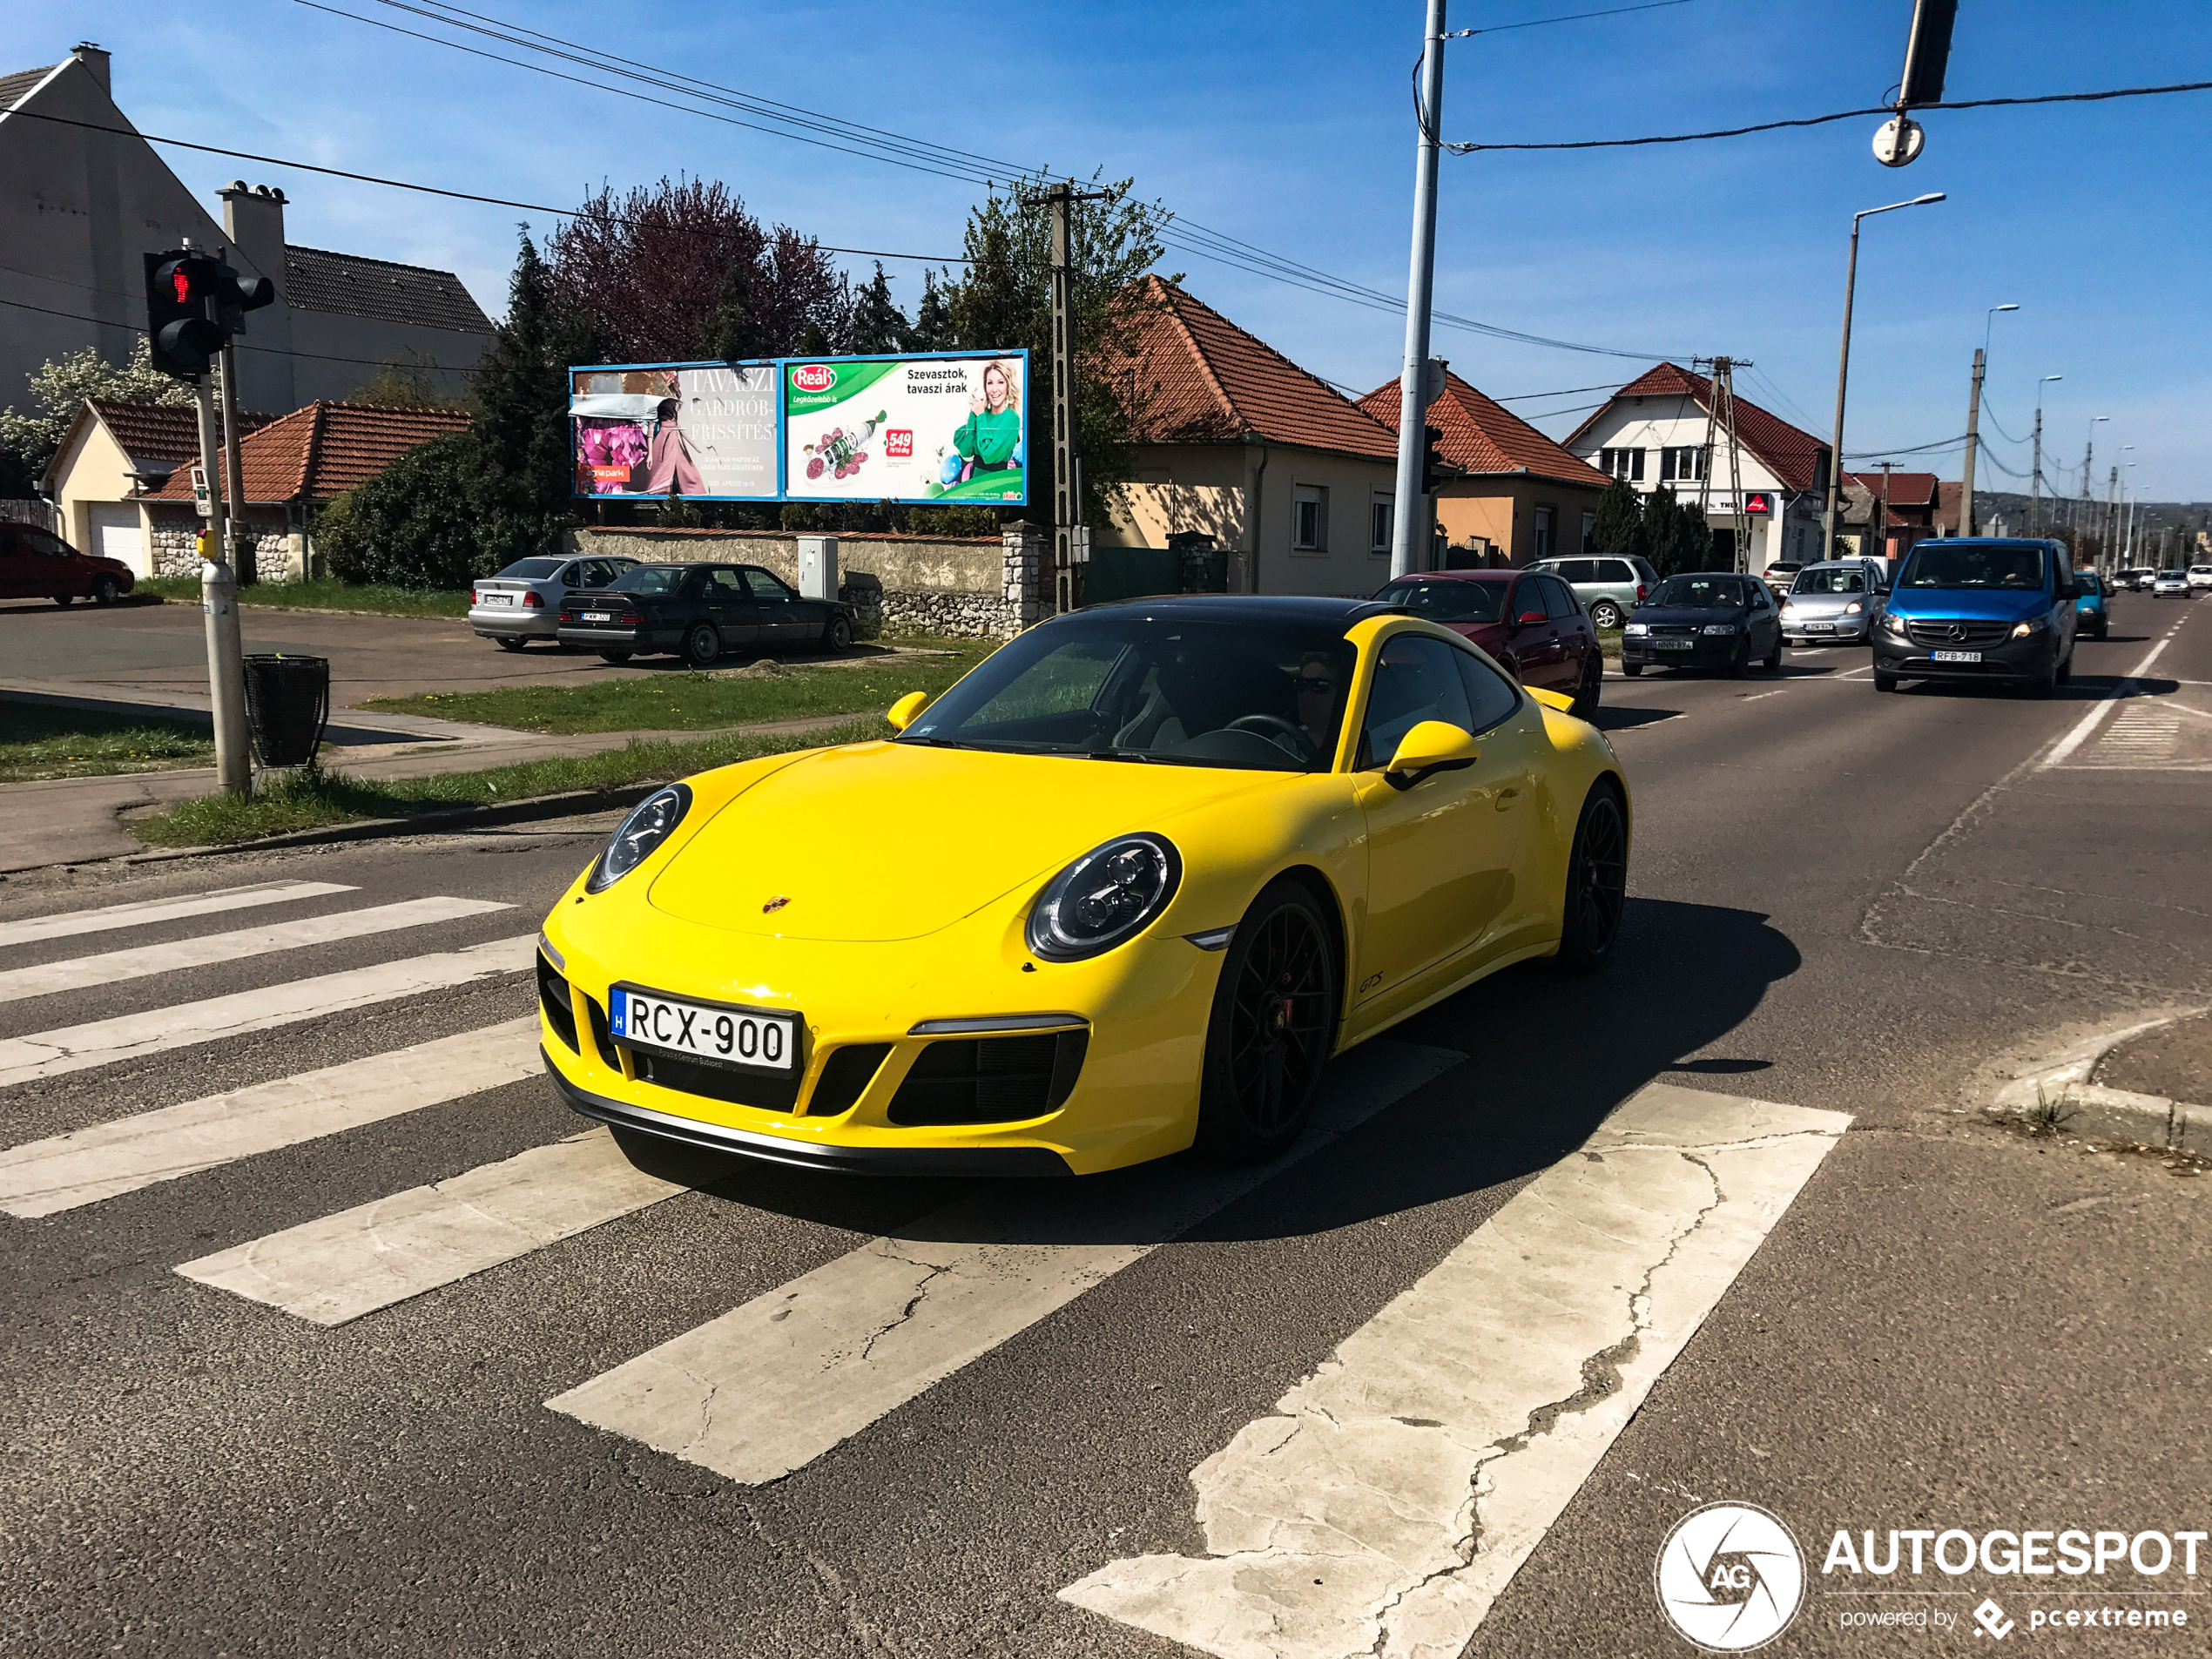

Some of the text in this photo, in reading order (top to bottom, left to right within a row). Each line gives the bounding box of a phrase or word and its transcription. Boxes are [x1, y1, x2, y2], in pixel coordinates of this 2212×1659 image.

[688, 368, 776, 393] TAVASZI
[797, 368, 827, 386] Reál
[907, 368, 968, 381] Szevasztok,
[907, 382, 968, 394] tavaszi árak
[690, 395, 774, 416] GARDRÓB-
[691, 420, 772, 441] FRISSÍTÉS
[889, 433, 912, 447] 549
[605, 469, 624, 478] park
[1937, 651, 1979, 661] RFB-718
[1359, 970, 1384, 993] GTS
[615, 997, 784, 1062] H RCX-900
[658, 1048, 724, 1069] Porsche Centrum Budapest
